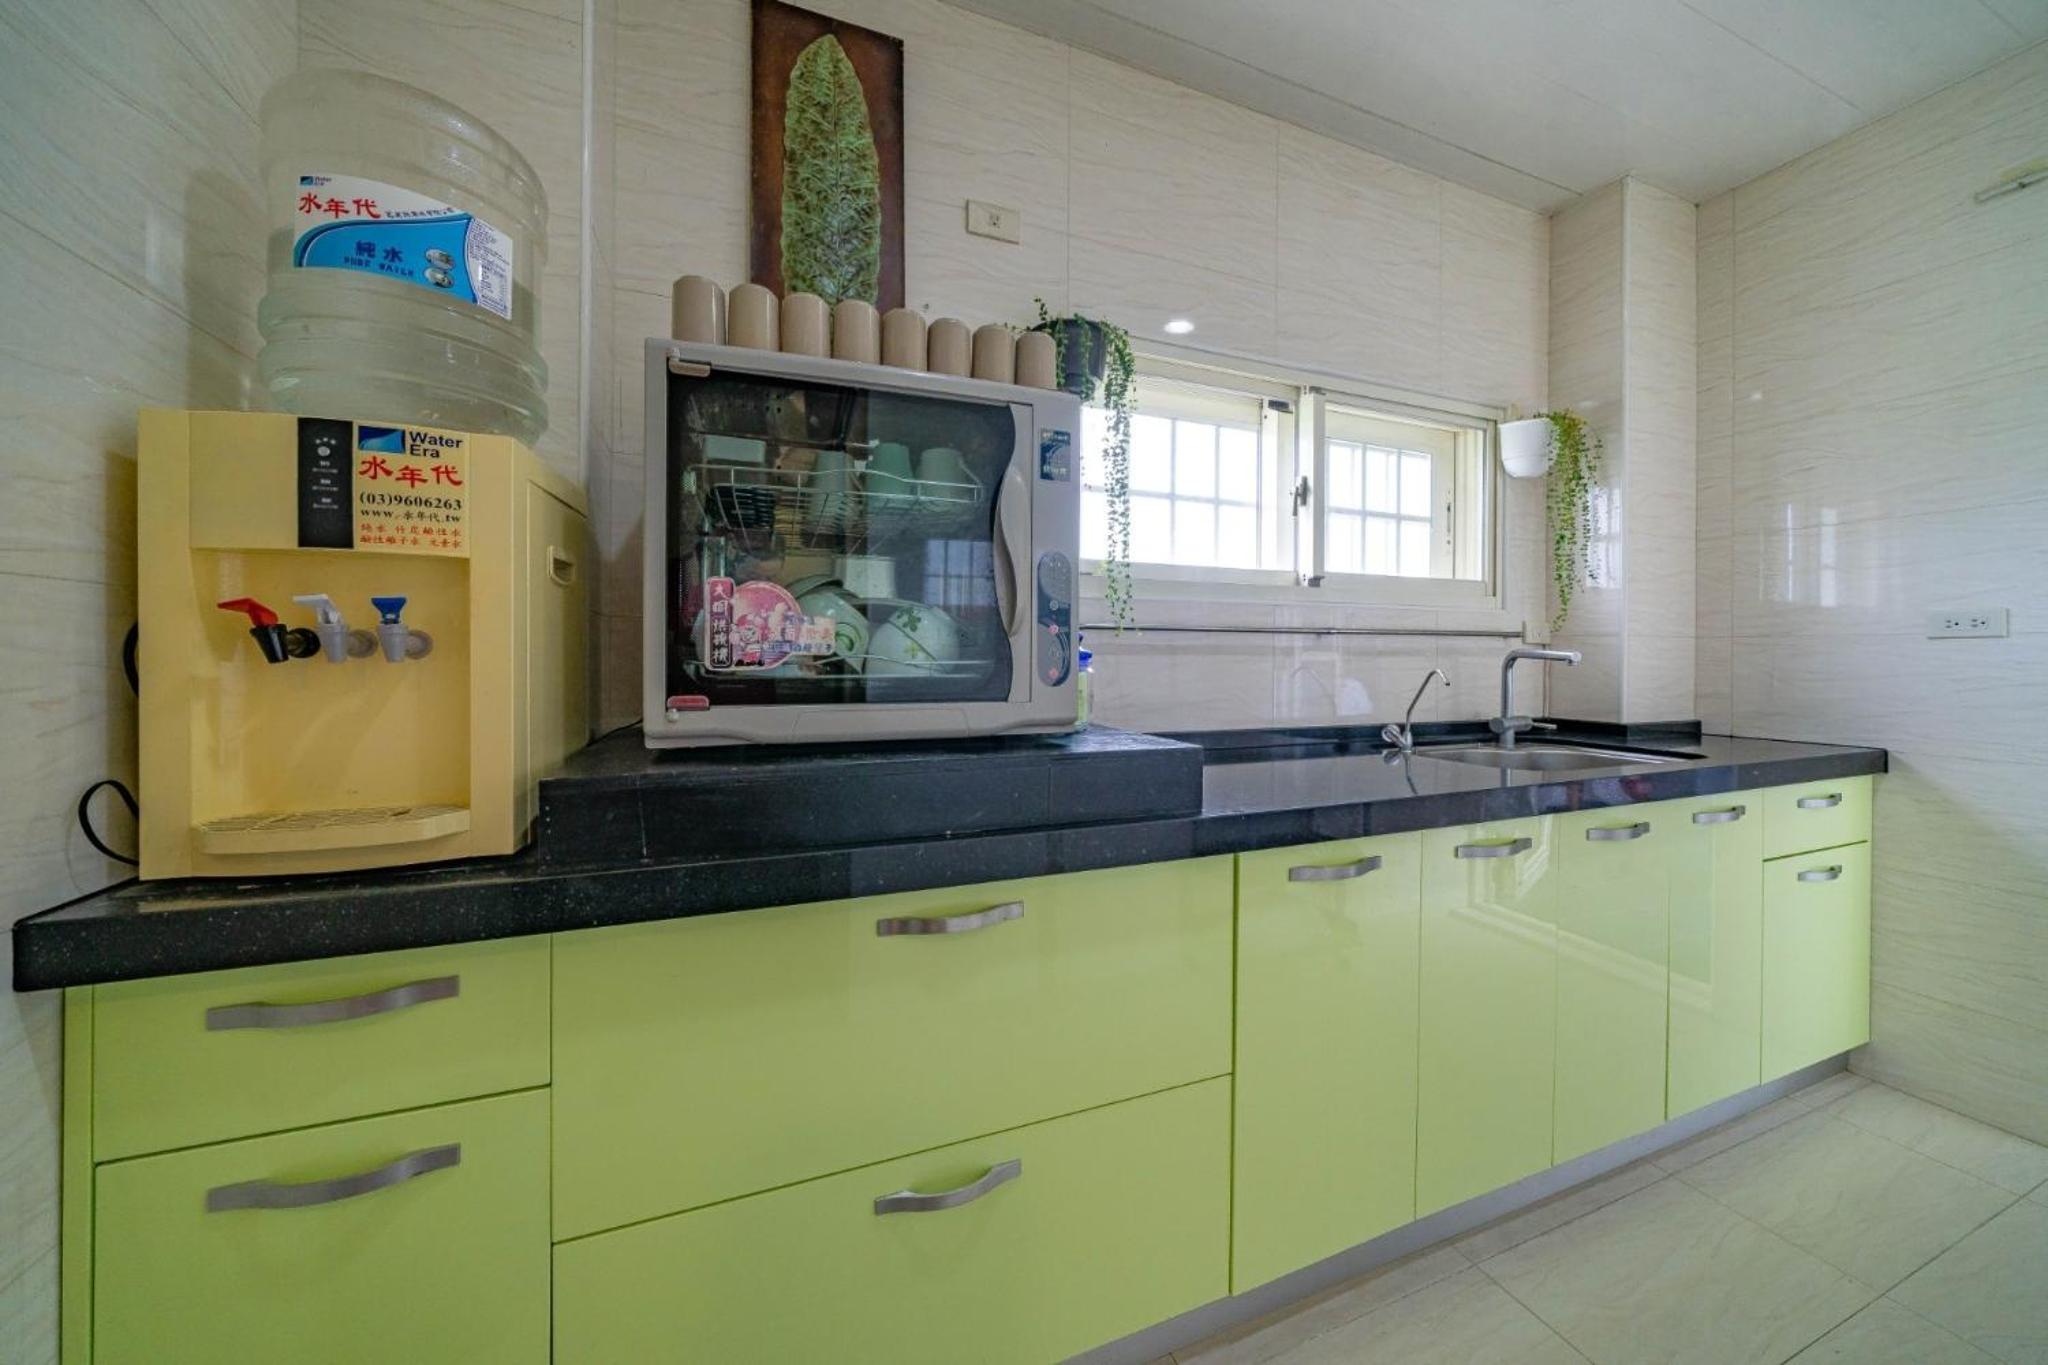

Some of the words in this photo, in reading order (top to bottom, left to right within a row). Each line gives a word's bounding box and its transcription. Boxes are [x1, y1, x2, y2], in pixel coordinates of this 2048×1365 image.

[298, 192, 381, 219] 水年代
[409, 430, 464, 448] Water
[410, 444, 440, 458] Era
[359, 455, 463, 489] 水年代
[360, 491, 462, 511] (03)9606263
